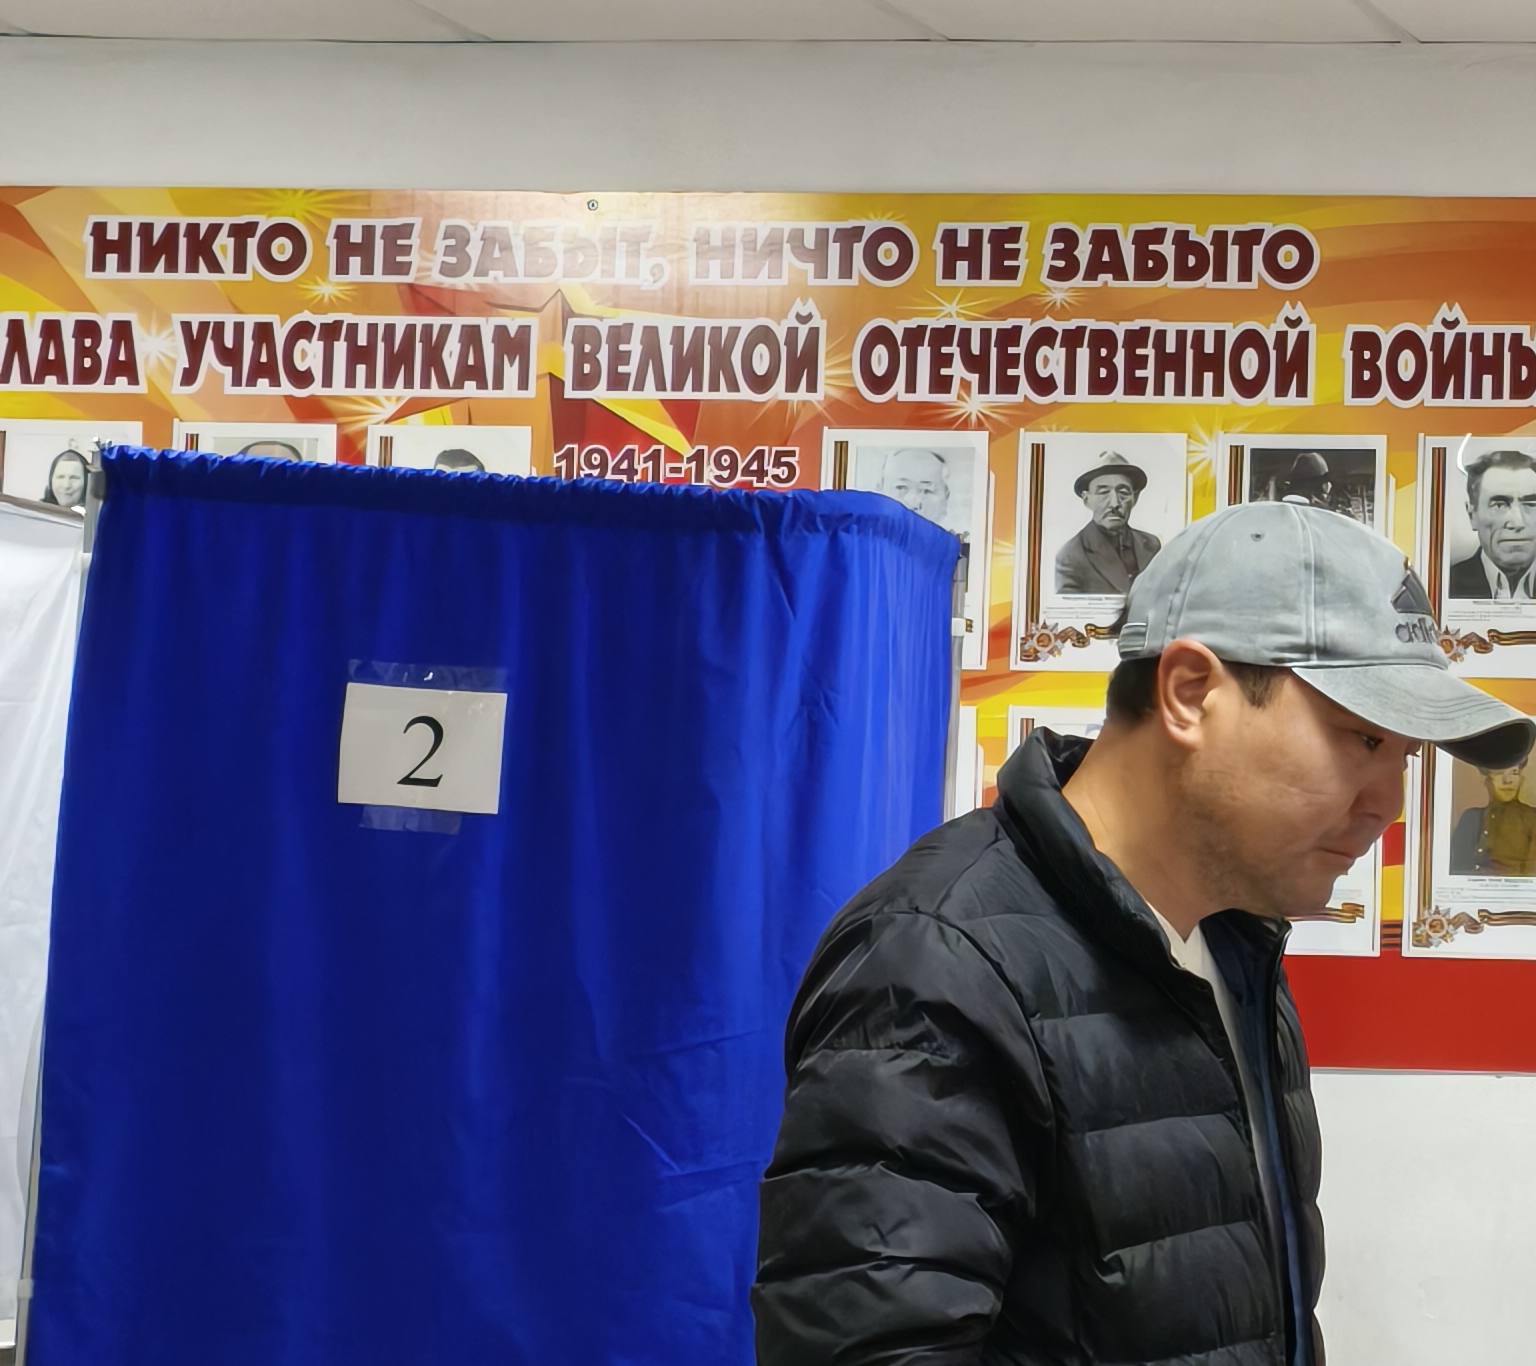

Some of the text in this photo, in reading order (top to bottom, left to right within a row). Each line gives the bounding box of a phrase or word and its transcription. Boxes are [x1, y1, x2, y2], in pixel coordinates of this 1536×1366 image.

[88, 220, 1316, 284] НИКТО НЕ ЗАБЫТ, НИЧТО НЕ ЗАБЫТО
[0, 318, 141, 386] ЛАВА
[179, 320, 533, 392] УЧАСТНИКАМ
[571, 308, 821, 395] ВЕЛИКОЙ
[859, 315, 1312, 400] ОТЕЧЕСТВЕННОЙ
[554, 445, 799, 487] 1941-1945
[396, 715, 444, 788] 2
